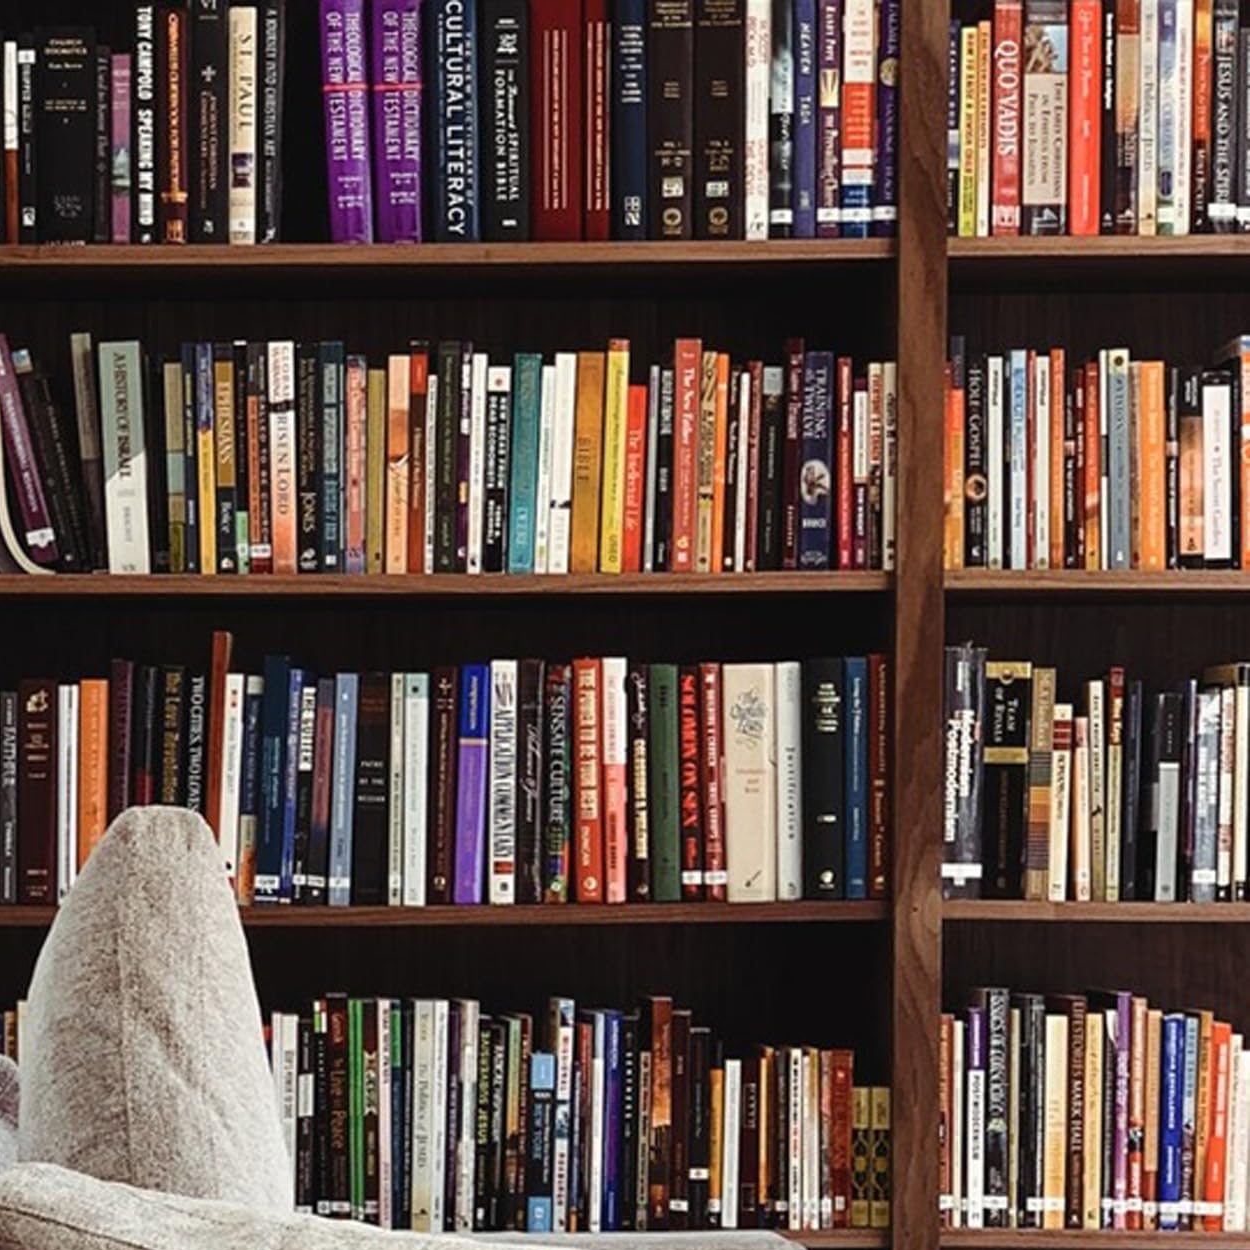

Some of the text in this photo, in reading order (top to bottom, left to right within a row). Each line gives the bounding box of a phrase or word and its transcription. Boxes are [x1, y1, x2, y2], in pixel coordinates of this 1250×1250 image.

[239, 34, 253, 132] ST. PAUL
[465, 32, 473, 56] THE
[465, 64, 473, 93] NEW
[800, 22, 811, 75] HEAVEN
[137, 6, 153, 225] TONY CAMPOLO SPEAKING MY MIND
[263, 87, 276, 136] CHRISTIAN
[326, 12, 348, 161] OF THE NEW TESTAMENT
[346, 12, 366, 161] THEOLOGICAL DICTIONARY
[382, 12, 401, 161] OF THE NEW TESTAMENT
[402, 12, 420, 161] THEOLOGICAL DICTIONARY
[446, 0, 465, 235] CULTURAL LITERACY
[995, 39, 1019, 156] QUO VADIS
[1053, 82, 1064, 102] THE
[1216, 56, 1233, 165] JESUS AND THE
[263, 139, 276, 157] ART
[465, 101, 473, 184] DICTIONARY
[495, 69, 508, 201] FORMATION BIBLE
[508, 133, 520, 201] SPIRITUAL
[1053, 138, 1064, 199] CHRISTIANS
[113, 352, 126, 363] A
[114, 364, 129, 416] HISTORY
[117, 416, 130, 433] OF
[486, 396, 498, 489] DEAD ECONOMISTS
[496, 396, 508, 489] NEW IDEAS FROM
[681, 368, 696, 444] The New Father
[802, 386, 815, 439] TWELVE
[814, 367, 829, 439] TRAINING
[969, 368, 983, 468] HOLE GOSPEL
[276, 416, 291, 515] RISEN LORD
[625, 428, 642, 529] The Intellectual Life
[1213, 456, 1223, 547] The Secret Garden
[220, 501, 232, 533] Boice
[302, 492, 317, 533] JONES
[608, 534, 618, 563] USED
[190, 676, 205, 705] TWO
[993, 687, 1006, 742] OF RIVALS
[1006, 698, 1019, 732] TEAM
[163, 672, 181, 803] the Love Revolution
[188, 747, 203, 775] TWO
[549, 696, 565, 824] SENSATE CULTURE
[681, 675, 699, 828] SOLOMON ON SEX
[959, 709, 976, 798] Modernism
[493, 709, 515, 858] APPLICATION COMMENTARY
[785, 746, 797, 840] Justification
[944, 719, 960, 842] Postmodernism
[581, 826, 591, 866] DUNCAN
[331, 1070, 346, 1096] Live
[971, 1075, 981, 1161] POSTMODERNISM
[1070, 1001, 1086, 1152] LIFESTORIES MARK HALL
[331, 1110, 346, 1149] Peace
[478, 1108, 490, 1144] JESUS
